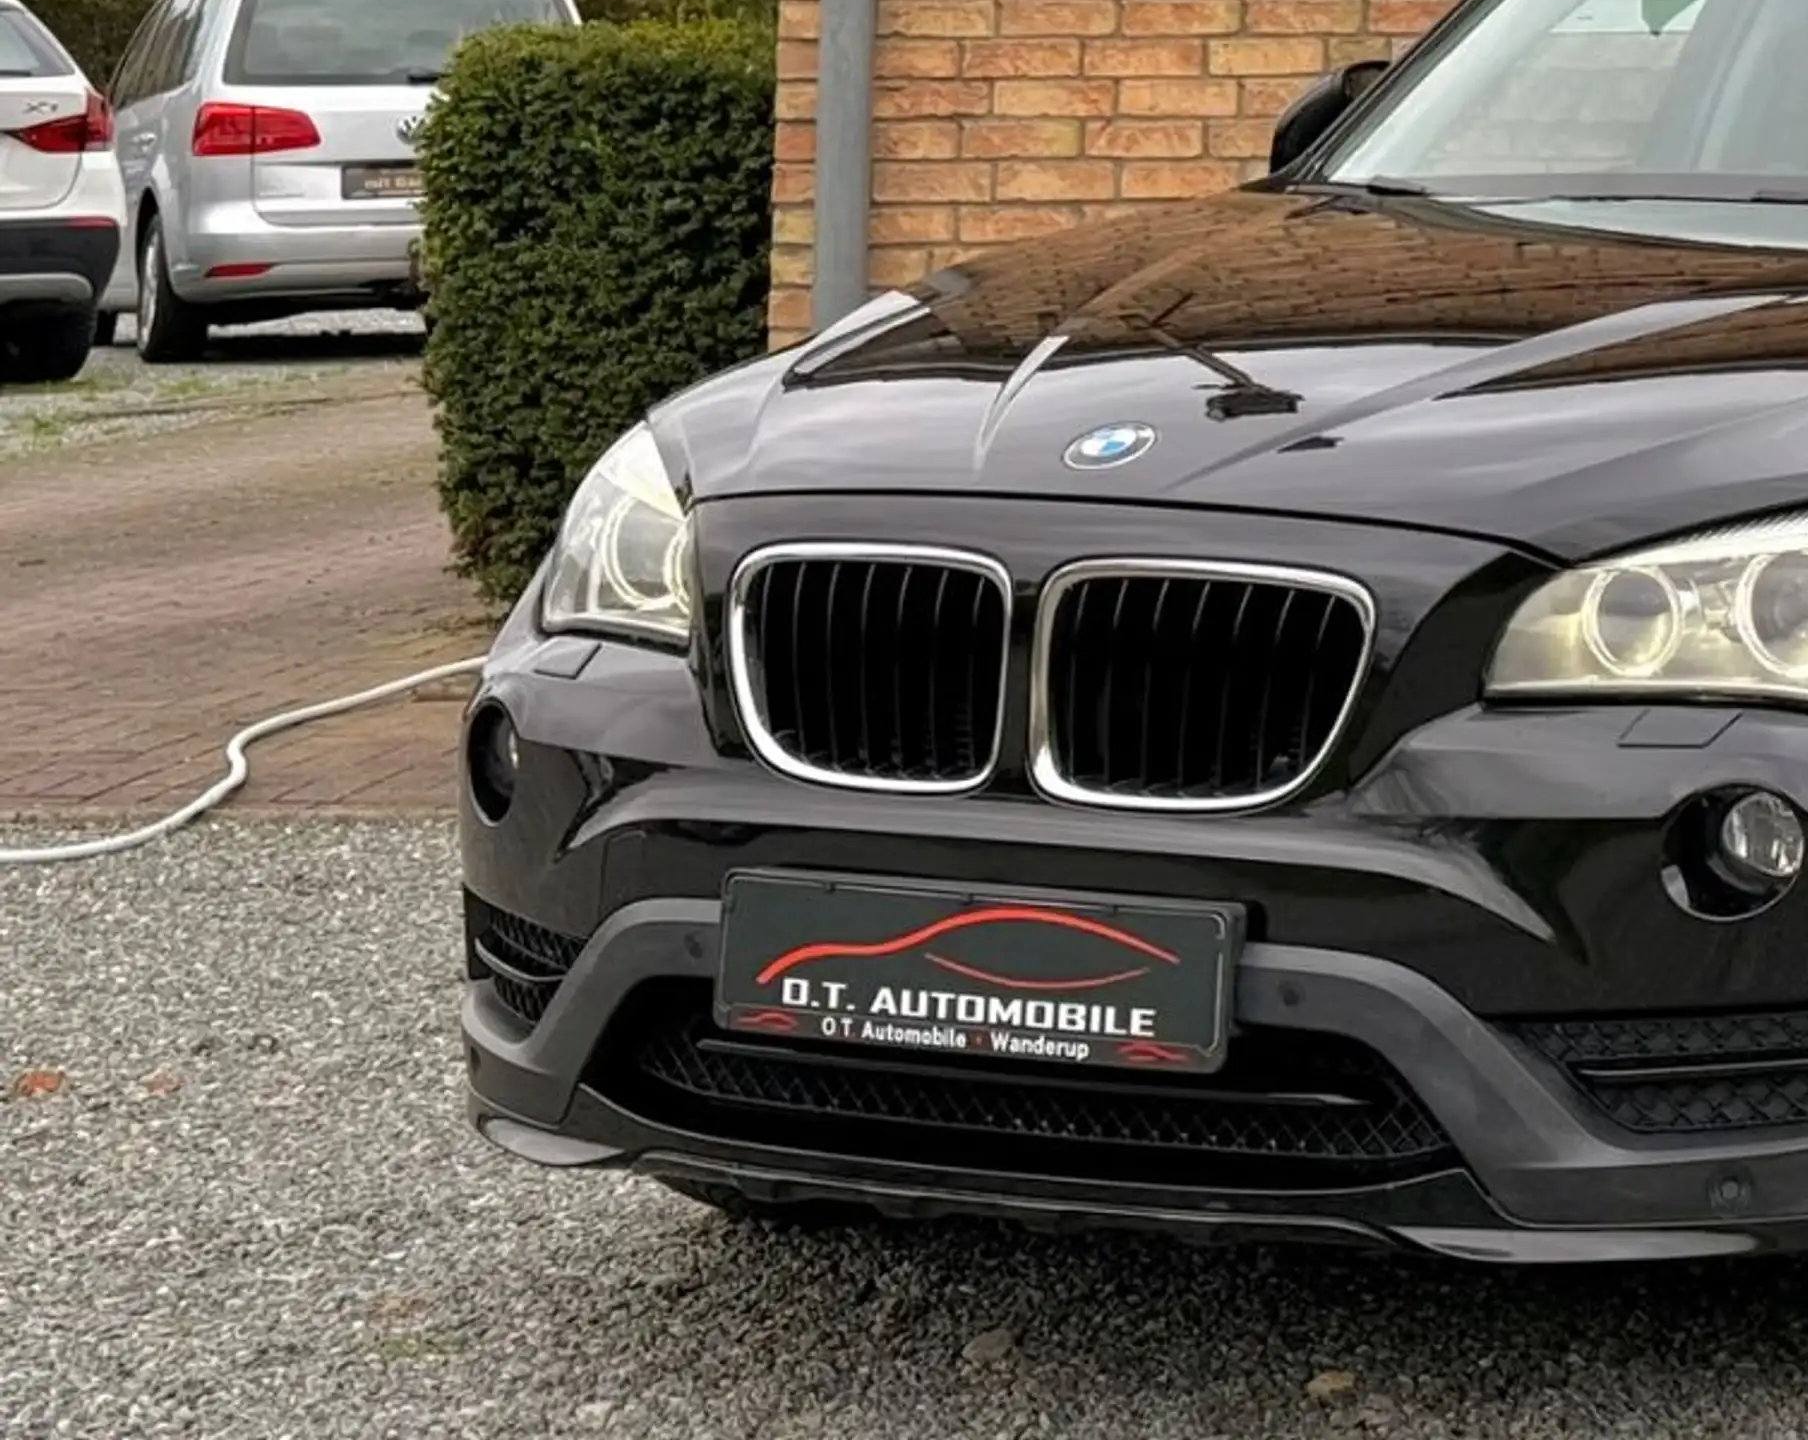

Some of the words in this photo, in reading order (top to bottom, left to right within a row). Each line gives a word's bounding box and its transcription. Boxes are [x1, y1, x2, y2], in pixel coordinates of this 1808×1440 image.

[782, 978, 856, 1011] O.T.
[870, 987, 1157, 1038] AUTOMOBILE
[861, 1021, 966, 1050] Automobile
[990, 1031, 1090, 1062] Wanderup
